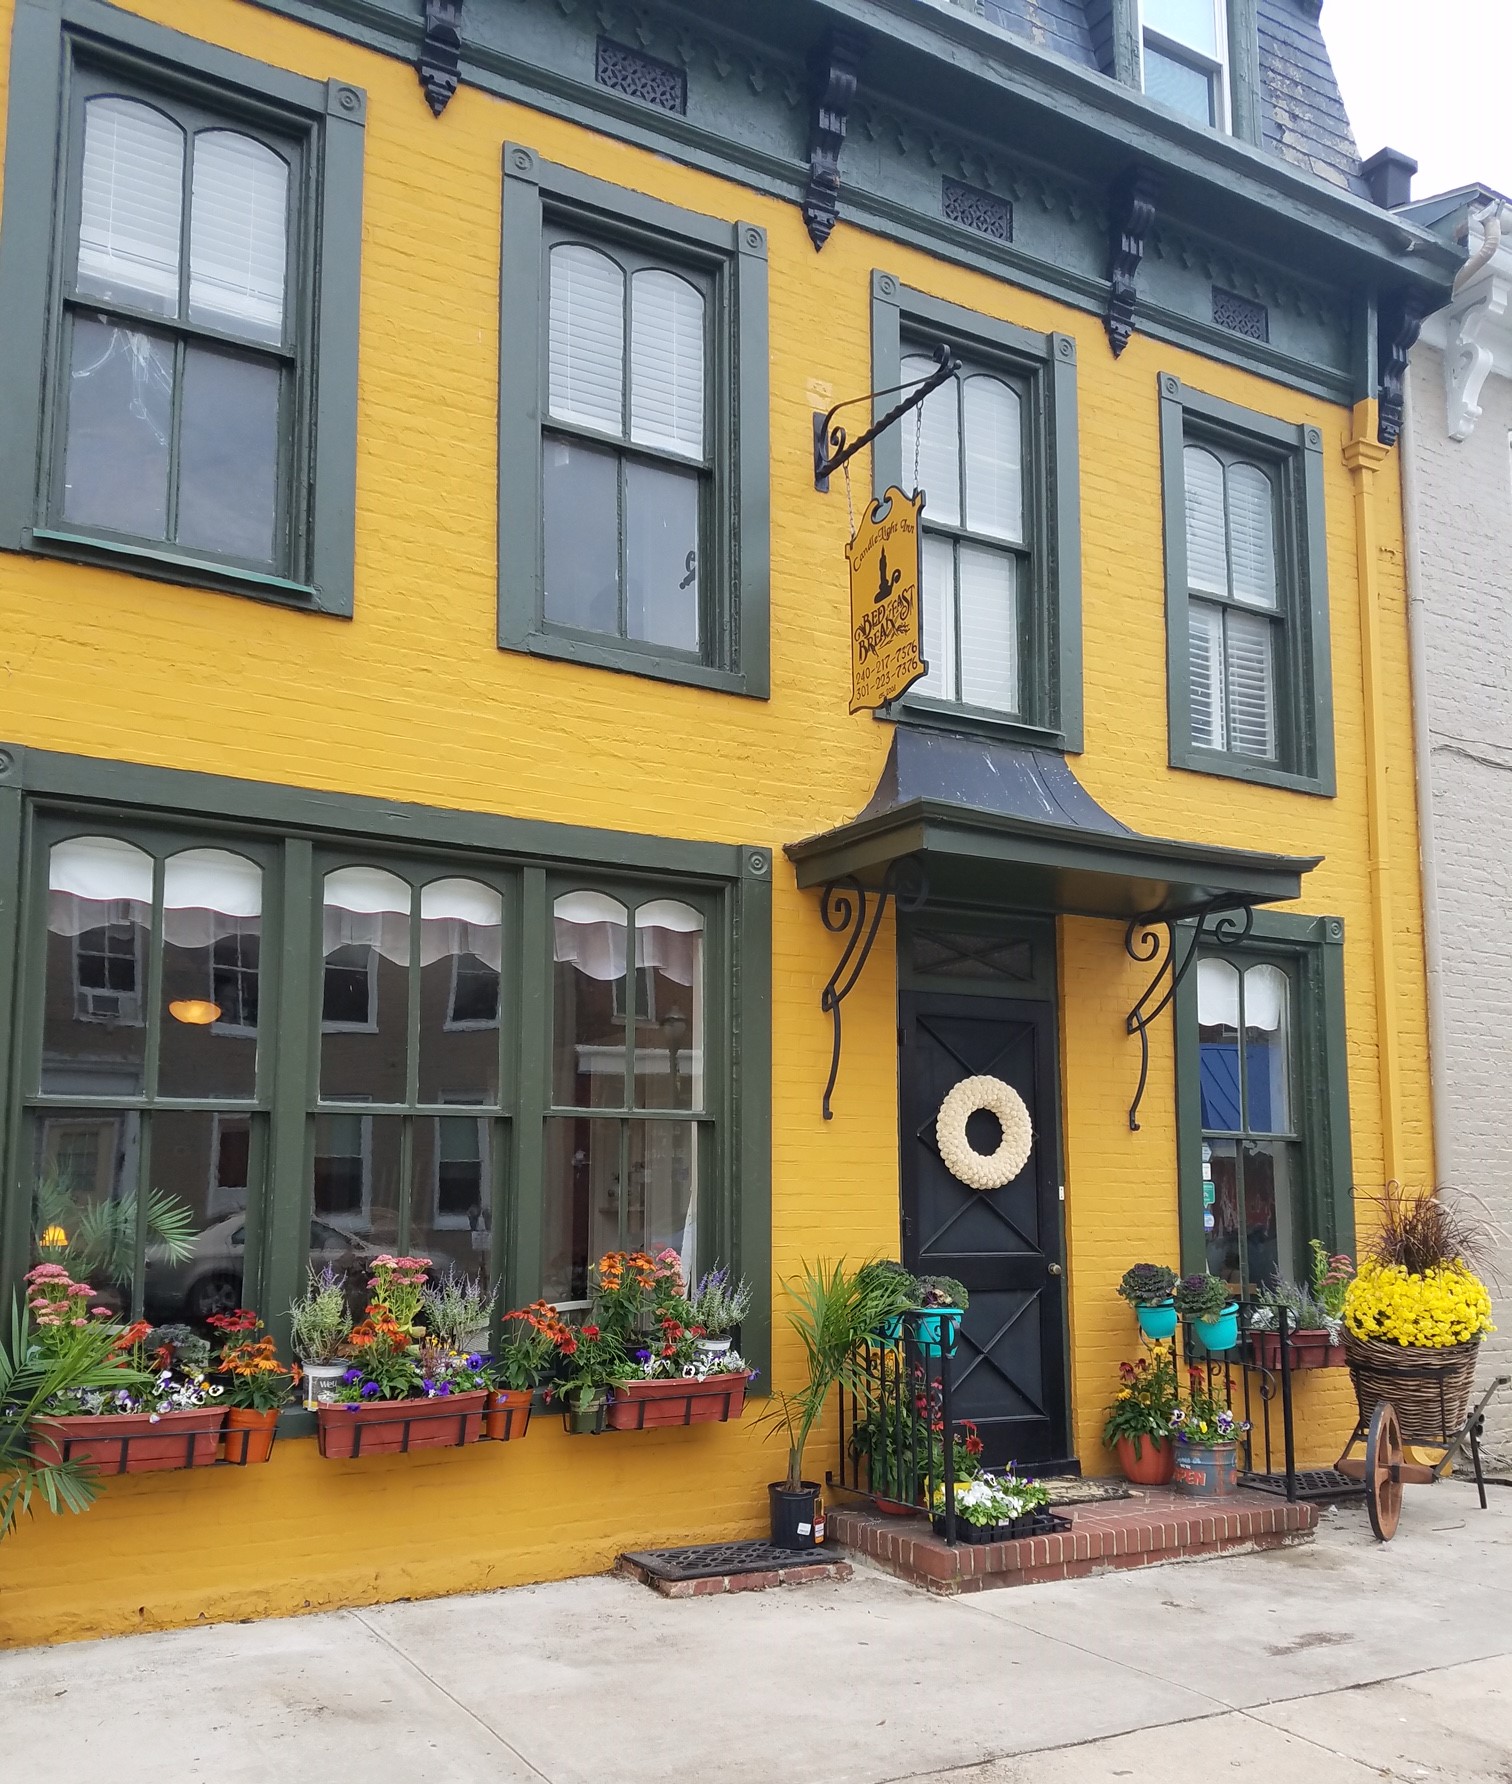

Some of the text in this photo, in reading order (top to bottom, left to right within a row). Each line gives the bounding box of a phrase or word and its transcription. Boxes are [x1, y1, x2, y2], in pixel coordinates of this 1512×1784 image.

[900, 519, 914, 533] Inn
[854, 605, 885, 641] BED
[856, 639, 917, 685] 240-217-7376
[856, 655, 918, 700] 301-223-7376
